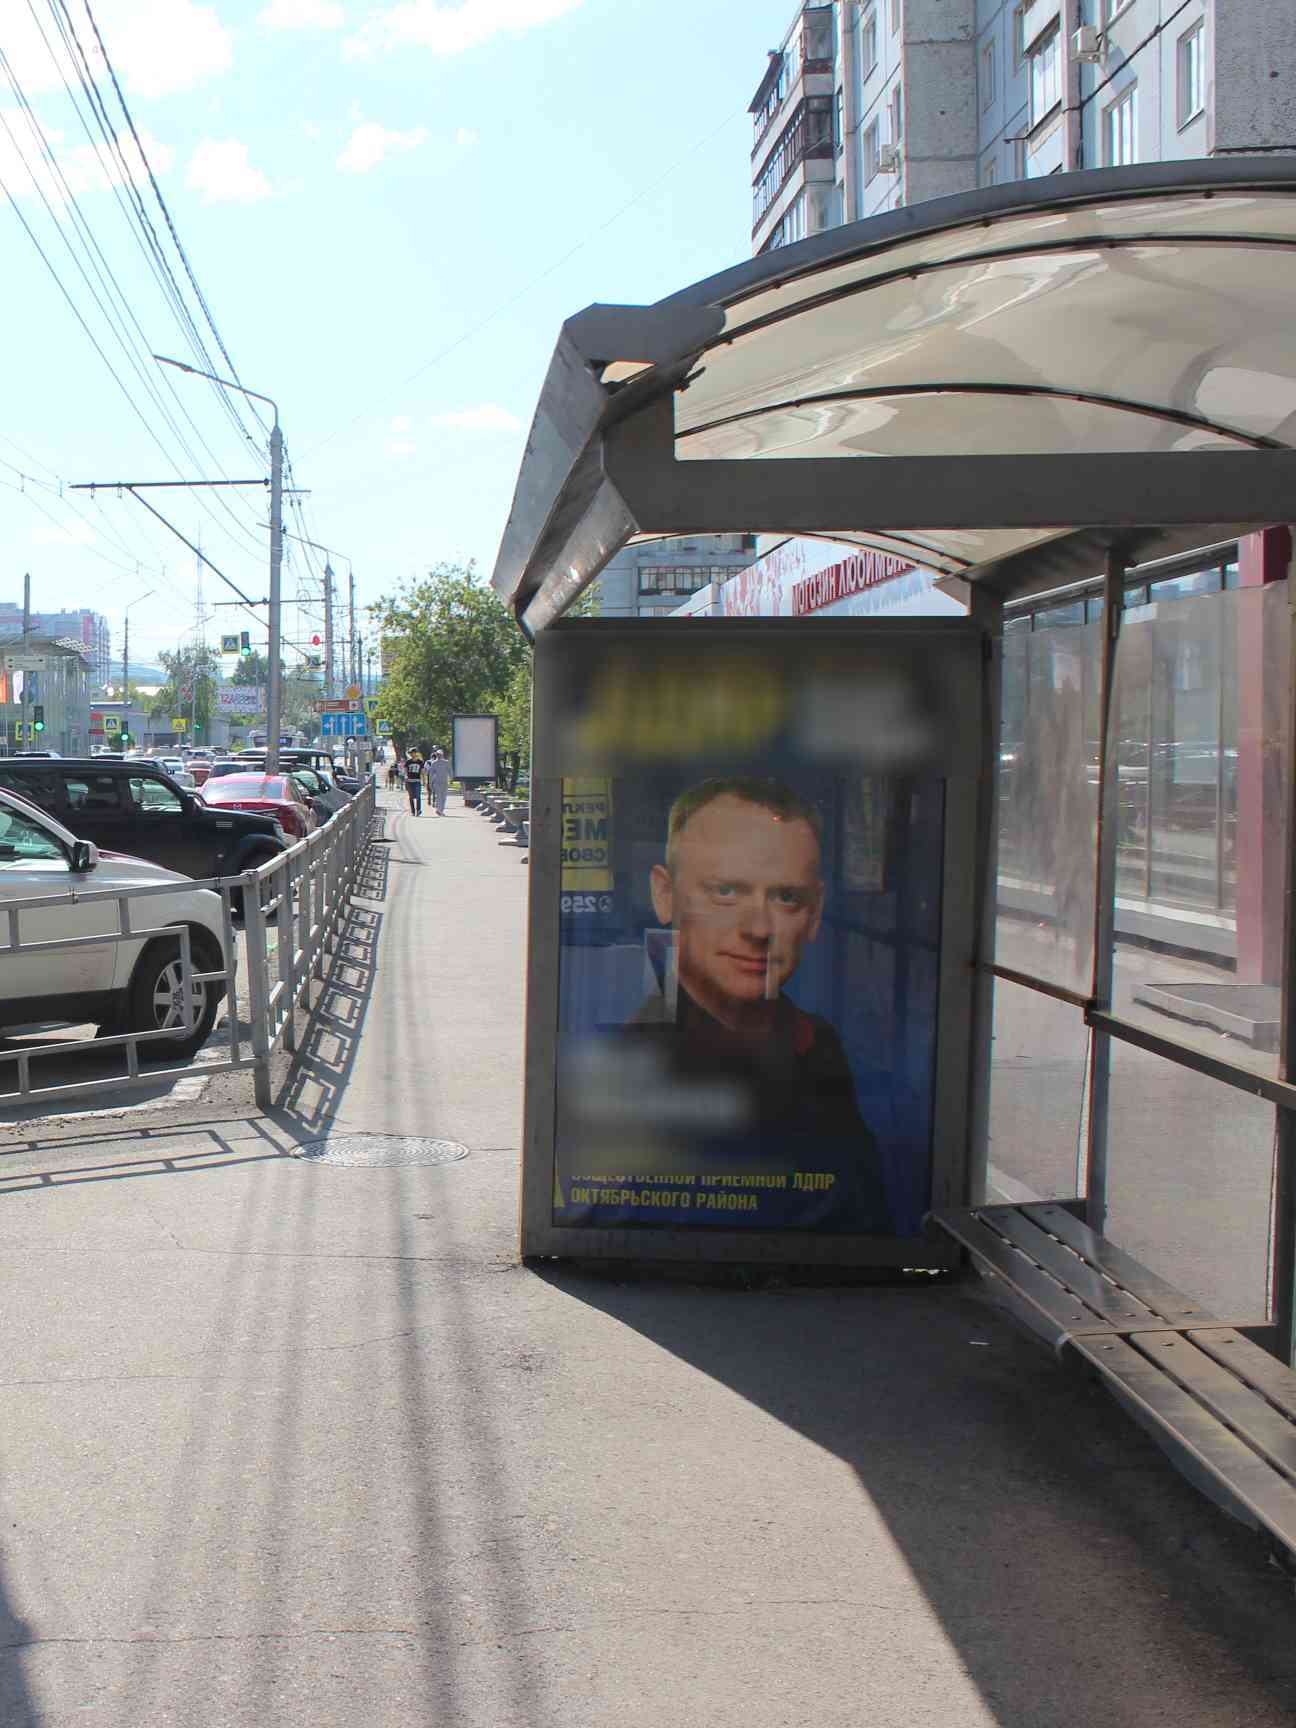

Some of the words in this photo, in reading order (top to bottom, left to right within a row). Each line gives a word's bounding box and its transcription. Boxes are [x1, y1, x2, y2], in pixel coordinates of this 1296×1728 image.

[791, 1171, 836, 1191] ЛДПР
[571, 1187, 691, 1208] ОКТЯБРЬСКОГО
[696, 1190, 759, 1211] РАЙОНА
